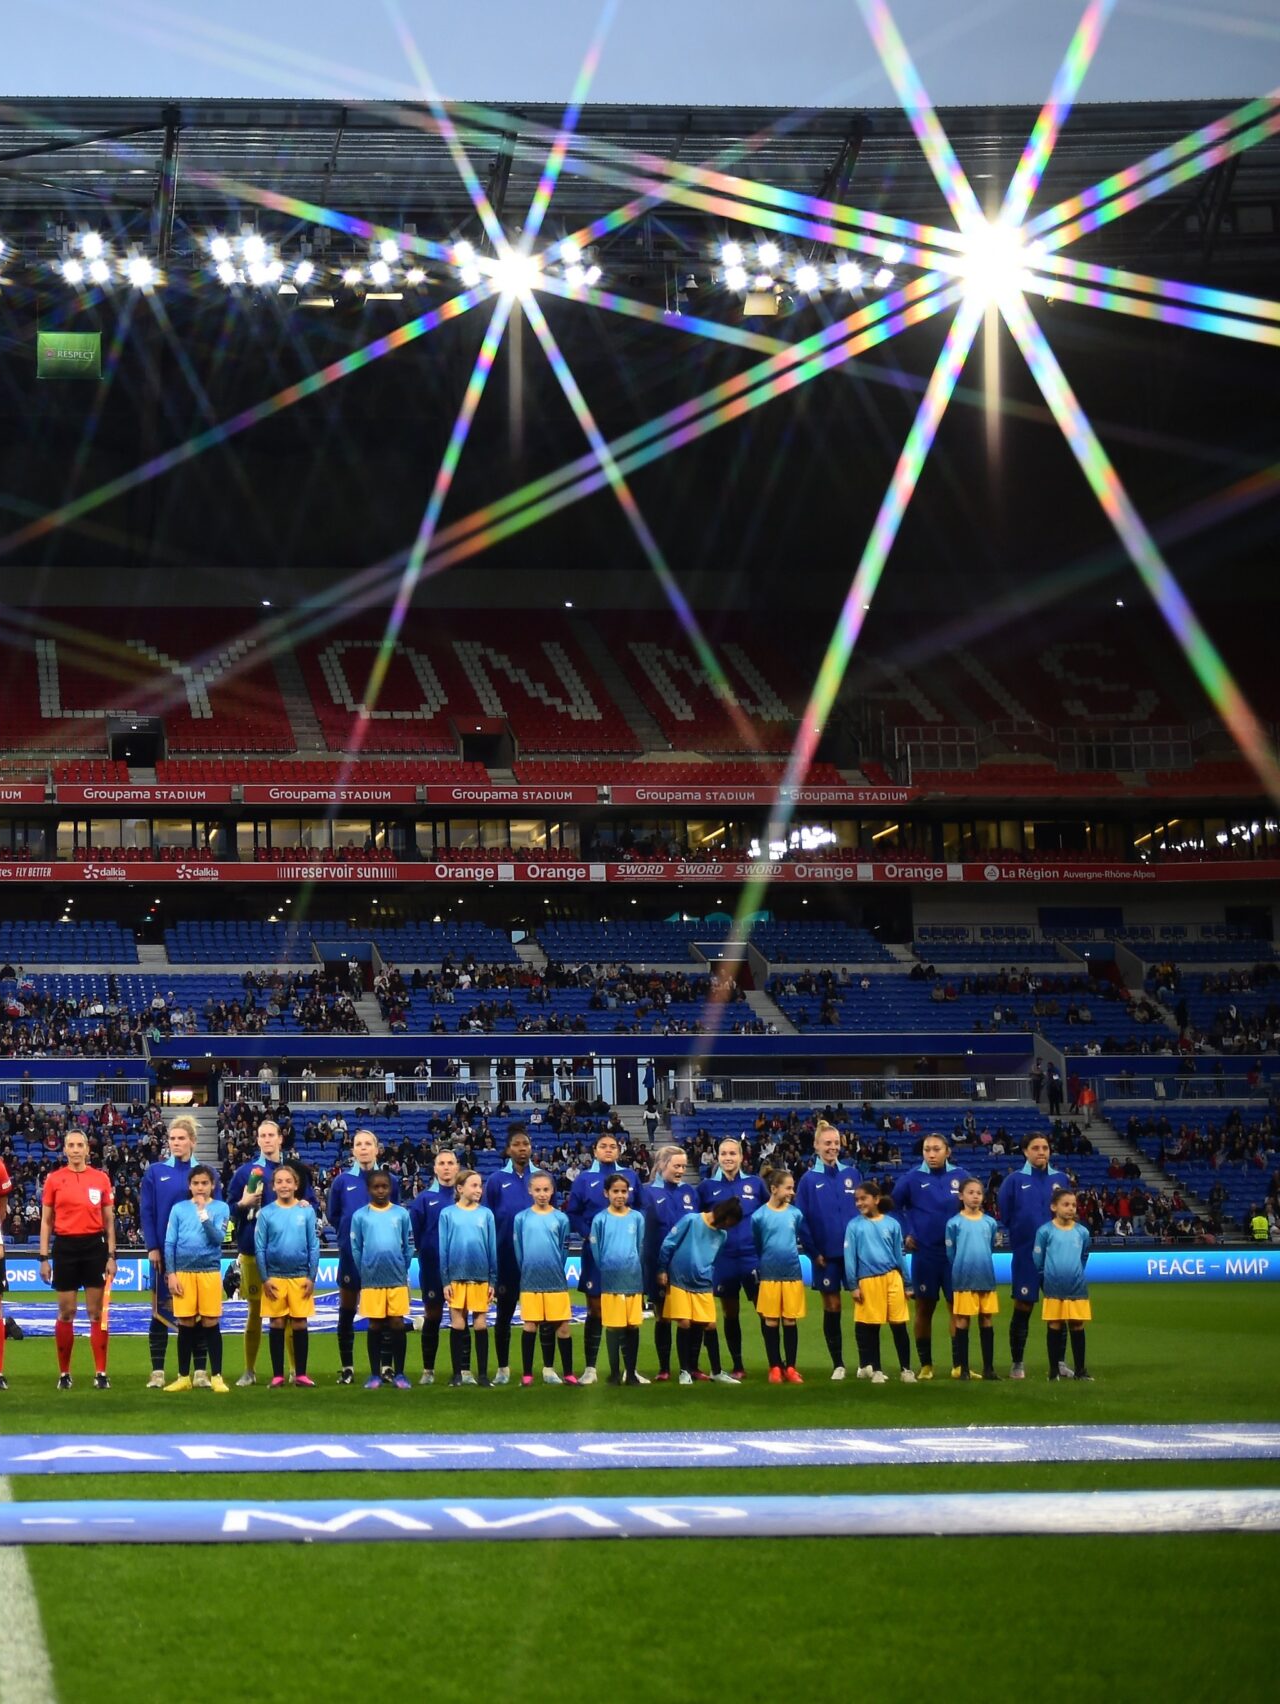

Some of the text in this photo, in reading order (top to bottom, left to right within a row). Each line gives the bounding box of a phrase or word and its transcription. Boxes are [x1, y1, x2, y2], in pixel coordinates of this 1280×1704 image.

[57, 350, 95, 360] RESPECT
[84, 788, 206, 800] Groupama STADIUM
[269, 788, 392, 800] Groupama STADIUM
[452, 788, 572, 800] Groupama STADIUM
[636, 788, 755, 800] Groupama STADIUM
[790, 788, 908, 800] Groupama STADIUM
[16, 867, 27, 877] FLY
[28, 867, 52, 877] BETTER
[100, 867, 126, 876] dalkia
[193, 867, 219, 876] dalkia
[435, 864, 494, 880] Orange
[527, 864, 586, 880] Orange
[616, 864, 664, 874] SWORD
[676, 864, 724, 874] SWORD
[736, 864, 782, 874] SWORD
[794, 864, 853, 880] Orange
[884, 864, 944, 880] Orange
[1002, 868, 1016, 878] La
[1018, 866, 1060, 880] Région
[1147, 1259, 1206, 1275] PEACE
[1225, 1258, 1269, 1275] МИР
[222, 1505, 748, 1532] МИР
